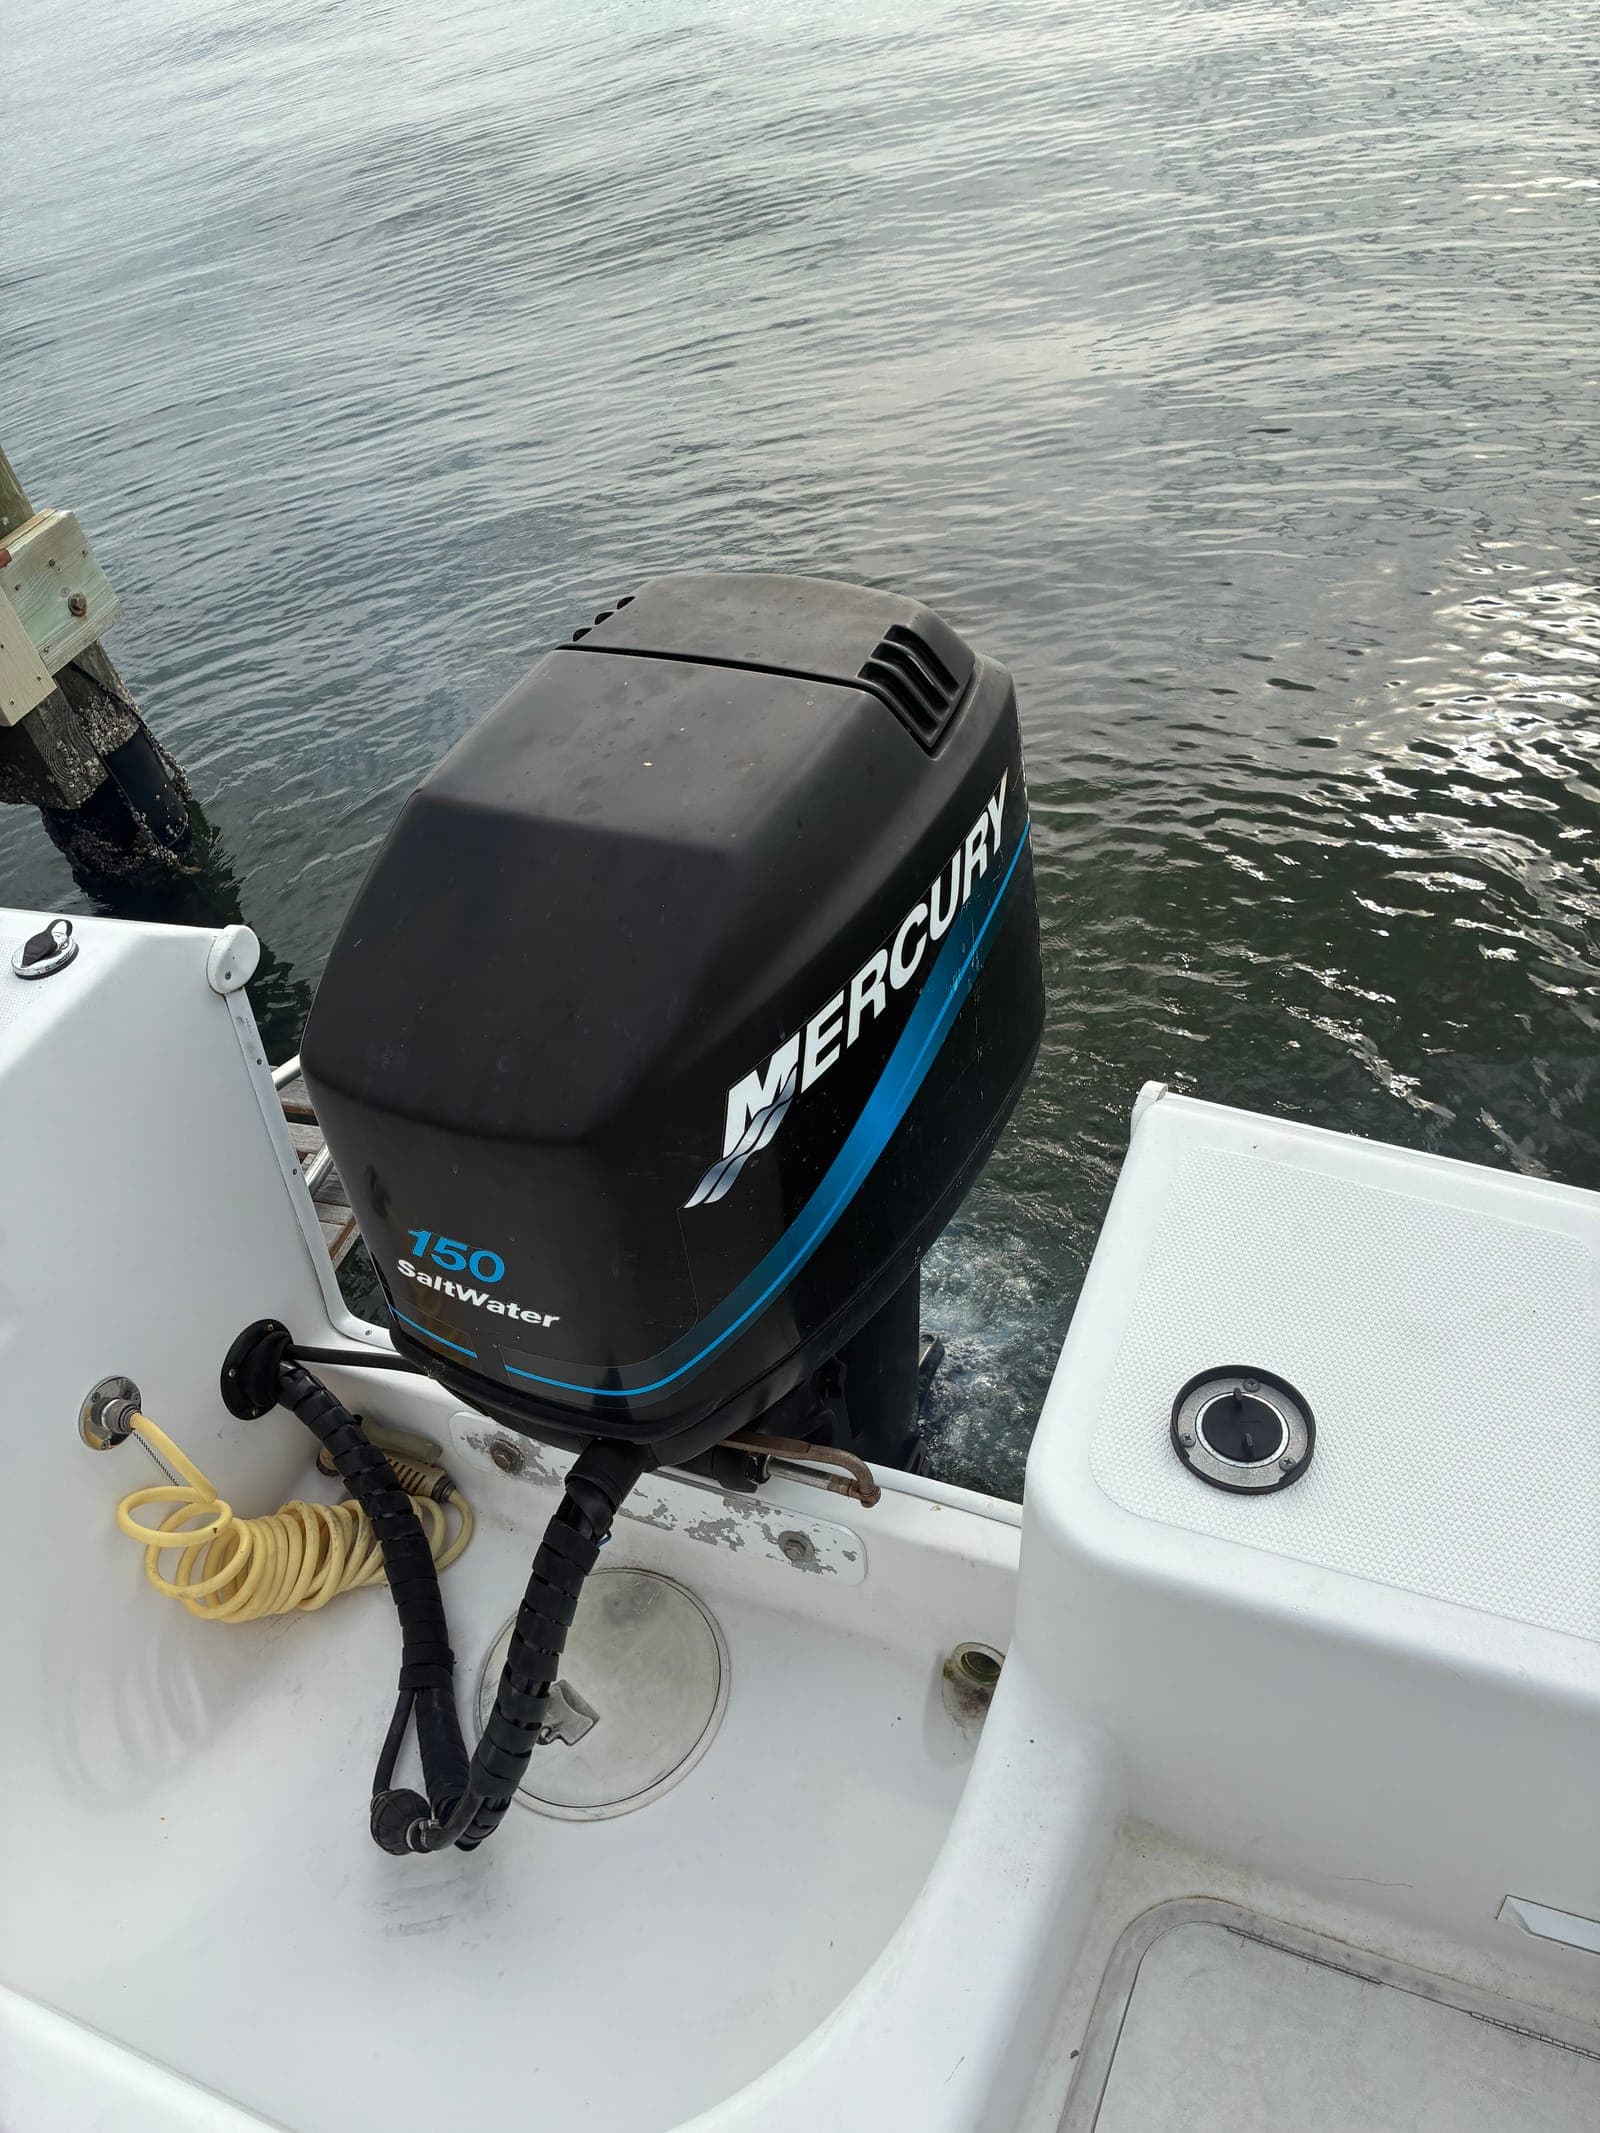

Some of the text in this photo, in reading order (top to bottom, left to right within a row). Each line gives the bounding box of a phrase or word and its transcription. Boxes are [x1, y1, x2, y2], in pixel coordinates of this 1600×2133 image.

[684, 767, 1008, 1208] MERCURY
[408, 1229, 505, 1283] 150
[397, 1259, 560, 1328] SaltWater
